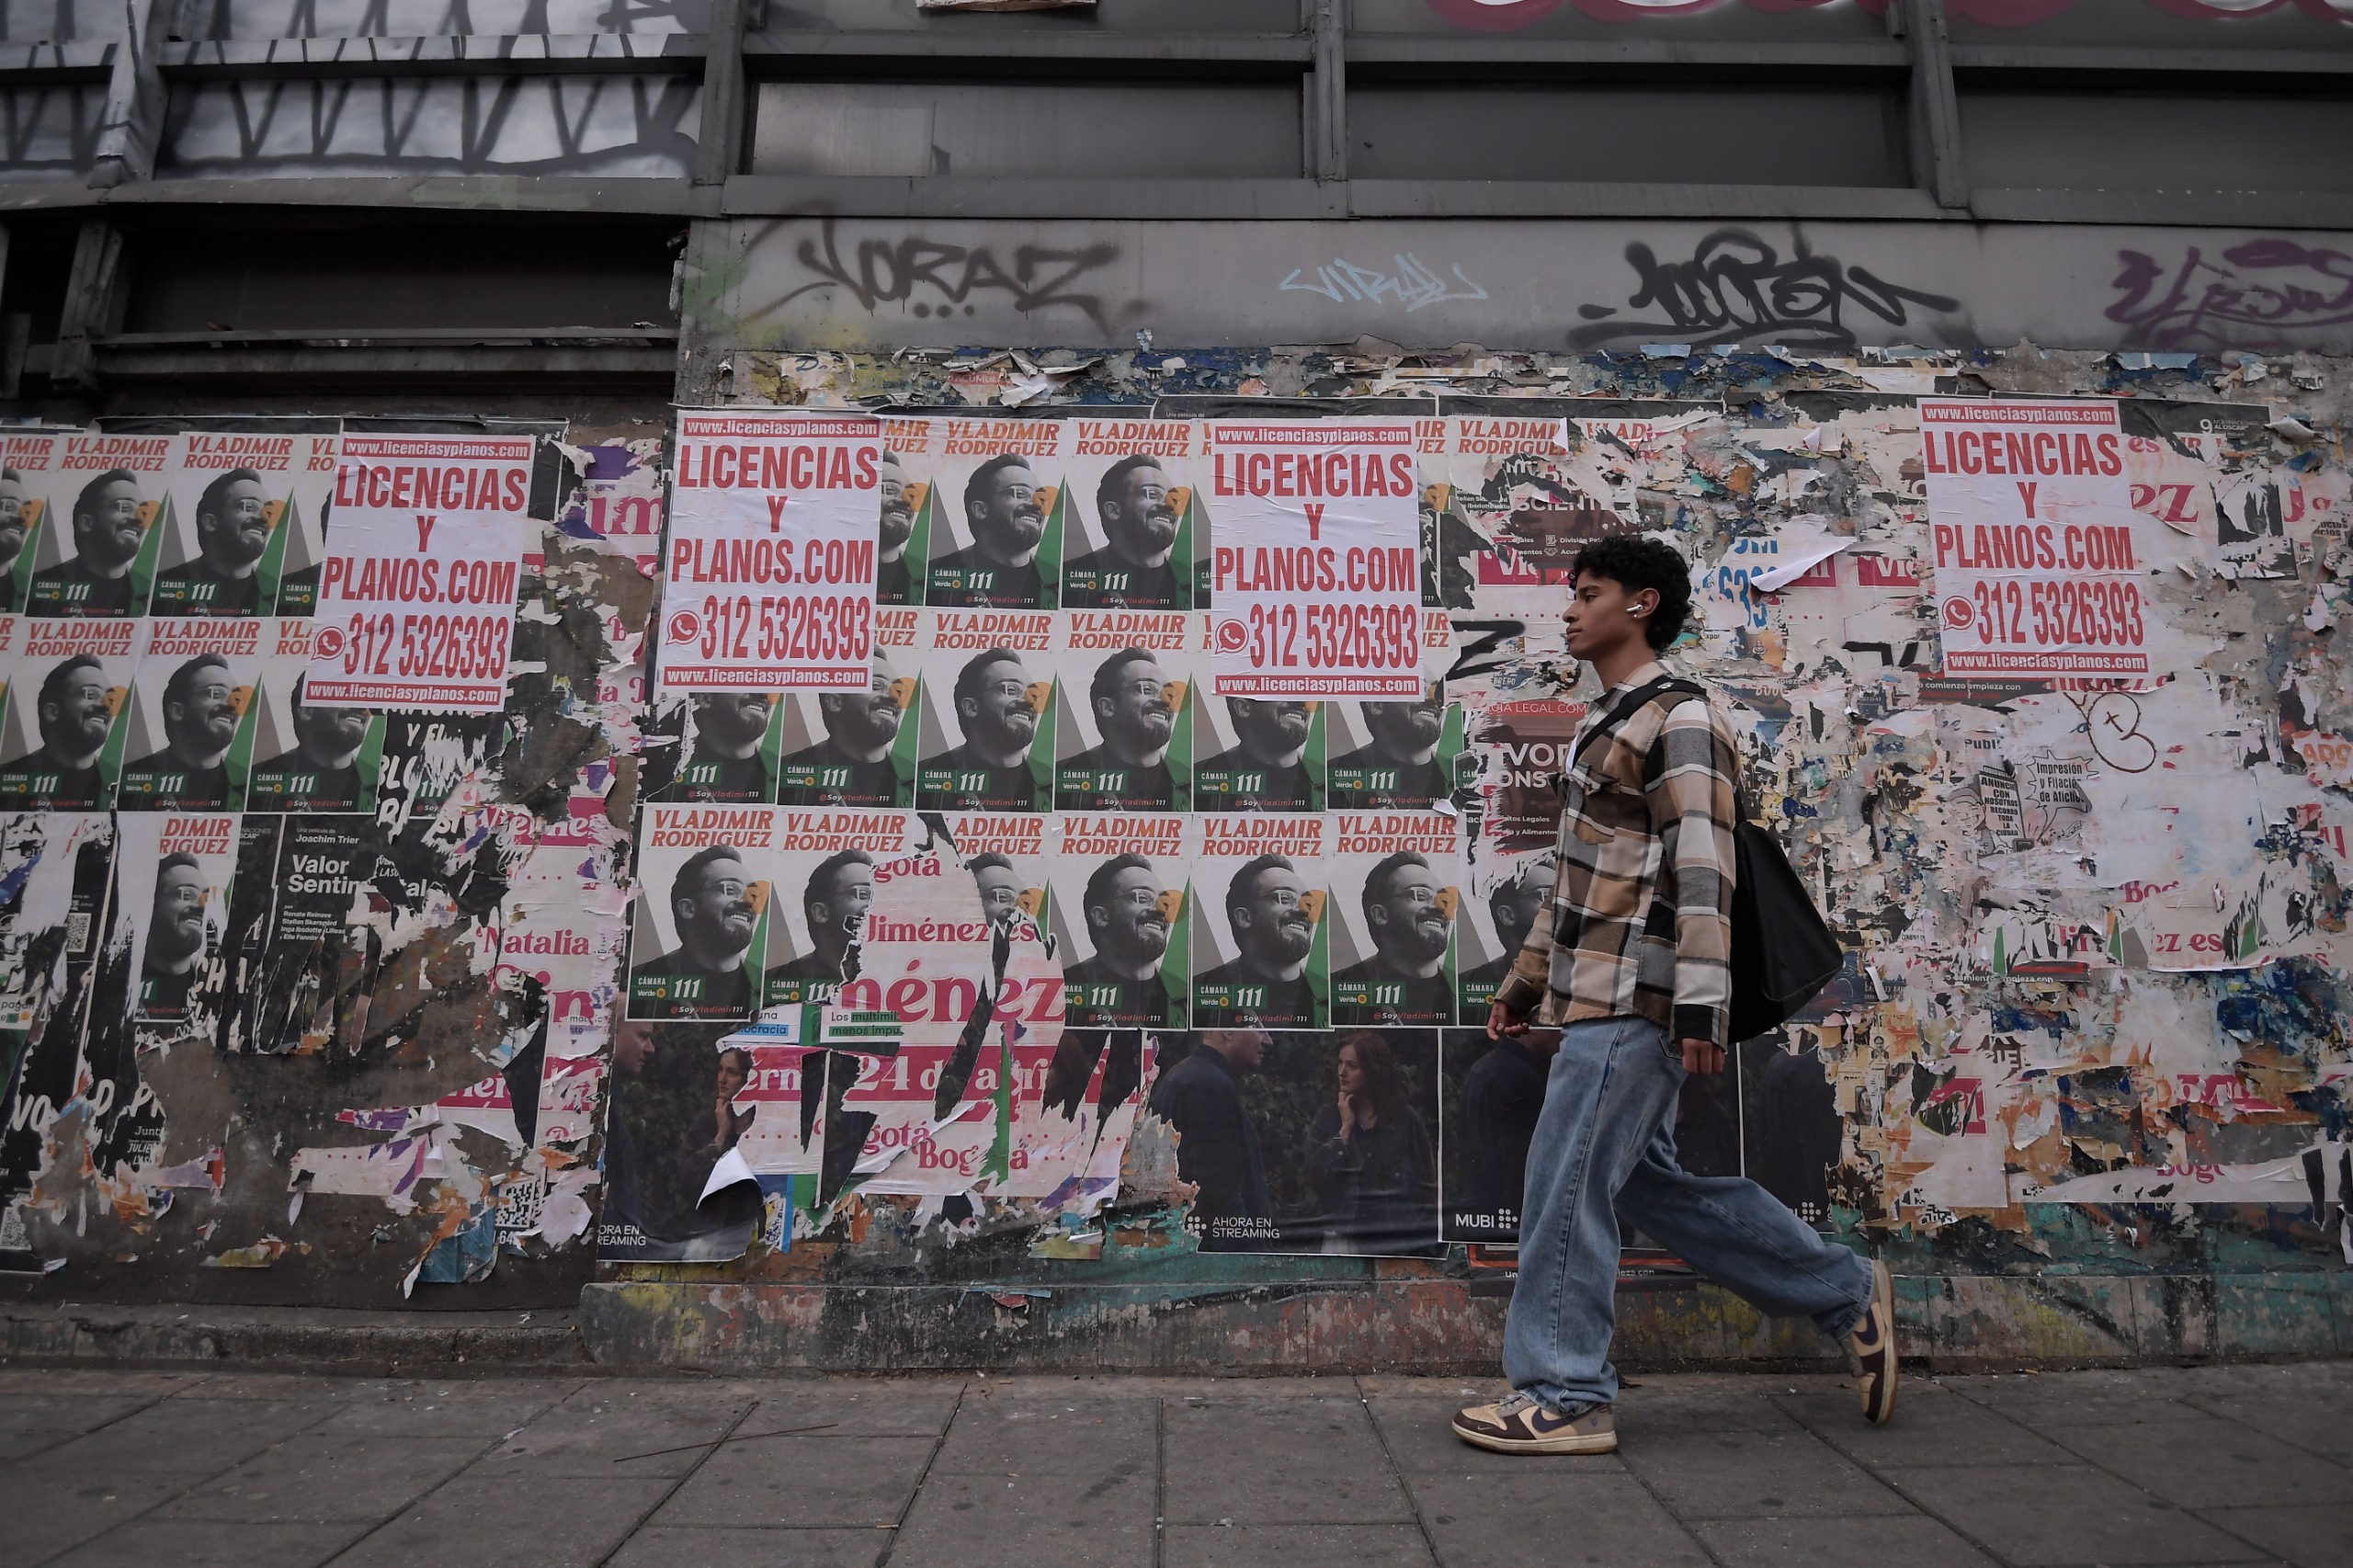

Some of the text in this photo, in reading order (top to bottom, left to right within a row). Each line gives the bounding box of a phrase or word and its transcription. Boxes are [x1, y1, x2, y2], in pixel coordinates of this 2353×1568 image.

[1925, 406, 2113, 425] www.licenciasyplanos.com
[687, 420, 877, 436] www.licenciasyplanos.com
[949, 422, 1061, 441] VLADIMIR
[1078, 422, 1191, 441] VLADIMIR
[1219, 428, 1409, 443] www.licenciasyplanos.com
[1460, 420, 1561, 439] VLADIMI
[2200, 419, 2213, 434] 9
[66, 436, 169, 456] VLADIMIR
[188, 436, 294, 454] VLADIMIR
[346, 442, 528, 458] www.licenciasyplanos.com
[945, 439, 1059, 457] RODRIGUEZ
[1075, 440, 1190, 458] RODRIGUEZ
[1924, 431, 2122, 477] LICENCIAS
[62, 456, 165, 471] RODRIGUEZ
[184, 455, 290, 471] RODRIGUEZ
[678, 445, 879, 490] LICENCIAS
[1214, 452, 1414, 498] LICENCIAS
[334, 465, 528, 512] LICENCIAS
[2017, 481, 2037, 519] Y
[767, 495, 789, 533] Y
[1303, 504, 1325, 540] Y
[417, 516, 438, 552] Y
[1935, 524, 2135, 572] PLANOS.COM
[671, 538, 873, 585] PLANOS.COM
[1215, 546, 1415, 592] PLANOS.COM
[322, 556, 517, 605] PLANOS.COM
[969, 572, 995, 589] 111
[1070, 570, 1129, 590] CÁMARA 111
[191, 585, 216, 601] 111
[1974, 579, 2144, 647] 312 5326393
[29, 622, 135, 640] VLADIMIR
[153, 621, 261, 639] VLADIMIR
[700, 595, 870, 661] 312 5326393
[937, 613, 1051, 633] VLADIMIR
[1070, 613, 1186, 632] VLADIMIR
[934, 633, 1050, 651] RODRIGUEZ
[1068, 632, 1186, 651] RODRIGUEZ
[1248, 603, 1419, 669] 312 5326393
[25, 641, 132, 656] RODRIGUEZ
[149, 640, 257, 655] RODRIGUEZ
[344, 612, 509, 680] 312 5326393
[1950, 653, 2146, 671] www.licenciasyplanos.com
[667, 667, 866, 685] www.licenciasyplanos.com
[1219, 676, 1416, 694] www.licenciasyplanos.com
[310, 682, 498, 702] www.licenciasyplanos.com
[1517, 704, 1555, 713] LEGAL
[691, 765, 718, 783] 111
[787, 766, 848, 787] CÁMARA 111
[1201, 772, 1228, 780] CÁMARA
[2037, 763, 2083, 774] Impresión
[33, 776, 59, 793] 111
[289, 776, 314, 793] 111
[925, 770, 985, 791] CÁMARA 111
[1098, 773, 1125, 791] 111
[1335, 769, 1395, 790] CÁMARA 111
[1981, 777, 2017, 791] ANUNCIE
[2048, 778, 2082, 789] Fijació
[1984, 797, 2018, 807] NOSOTROS
[1994, 790, 2009, 799] CON
[2040, 791, 2051, 802] de
[164, 818, 233, 836] DIMIR
[654, 810, 774, 829] VLADIMIR
[787, 813, 906, 835] VLADIMIR
[953, 818, 1044, 836] ADIMIR
[1063, 818, 1182, 838] VLADIMIR
[1204, 818, 1323, 838] VLADIMIR
[1337, 816, 1458, 835] VLADIMIR
[159, 838, 230, 855] RIGUEZ
[296, 835, 360, 844] Joachim Trier
[651, 831, 770, 847] RODRIGUEZ
[783, 835, 905, 853] RODRIGUEZ
[956, 838, 1042, 855] DRIGUEZ
[1062, 838, 1180, 857] RODRIGUEZ
[1336, 836, 1456, 855] RODRIGUEZ
[1202, 840, 1322, 857] RODRIGUEZ
[292, 855, 350, 874] Valor
[289, 875, 426, 897] Sentital
[868, 915, 988, 943] Jiménez
[674, 980, 700, 998] 111
[772, 980, 800, 989] CÁMARA
[1338, 983, 1366, 992] CÁMARA
[1090, 987, 1118, 1006] 111
[1200, 985, 1263, 1007] CÁMARA 111
[831, 1011, 848, 1022] Los
[737, 1024, 787, 1035] ocracia
[832, 1026, 868, 1035] menos
[858, 1056, 910, 1091] 24
[599, 1224, 640, 1235] ORA EN
[1212, 1217, 1272, 1228] AHORA EN
[1455, 1213, 1495, 1228] MUBI
[597, 1235, 646, 1246] REAMING
[1212, 1228, 1279, 1239] STREAMING
